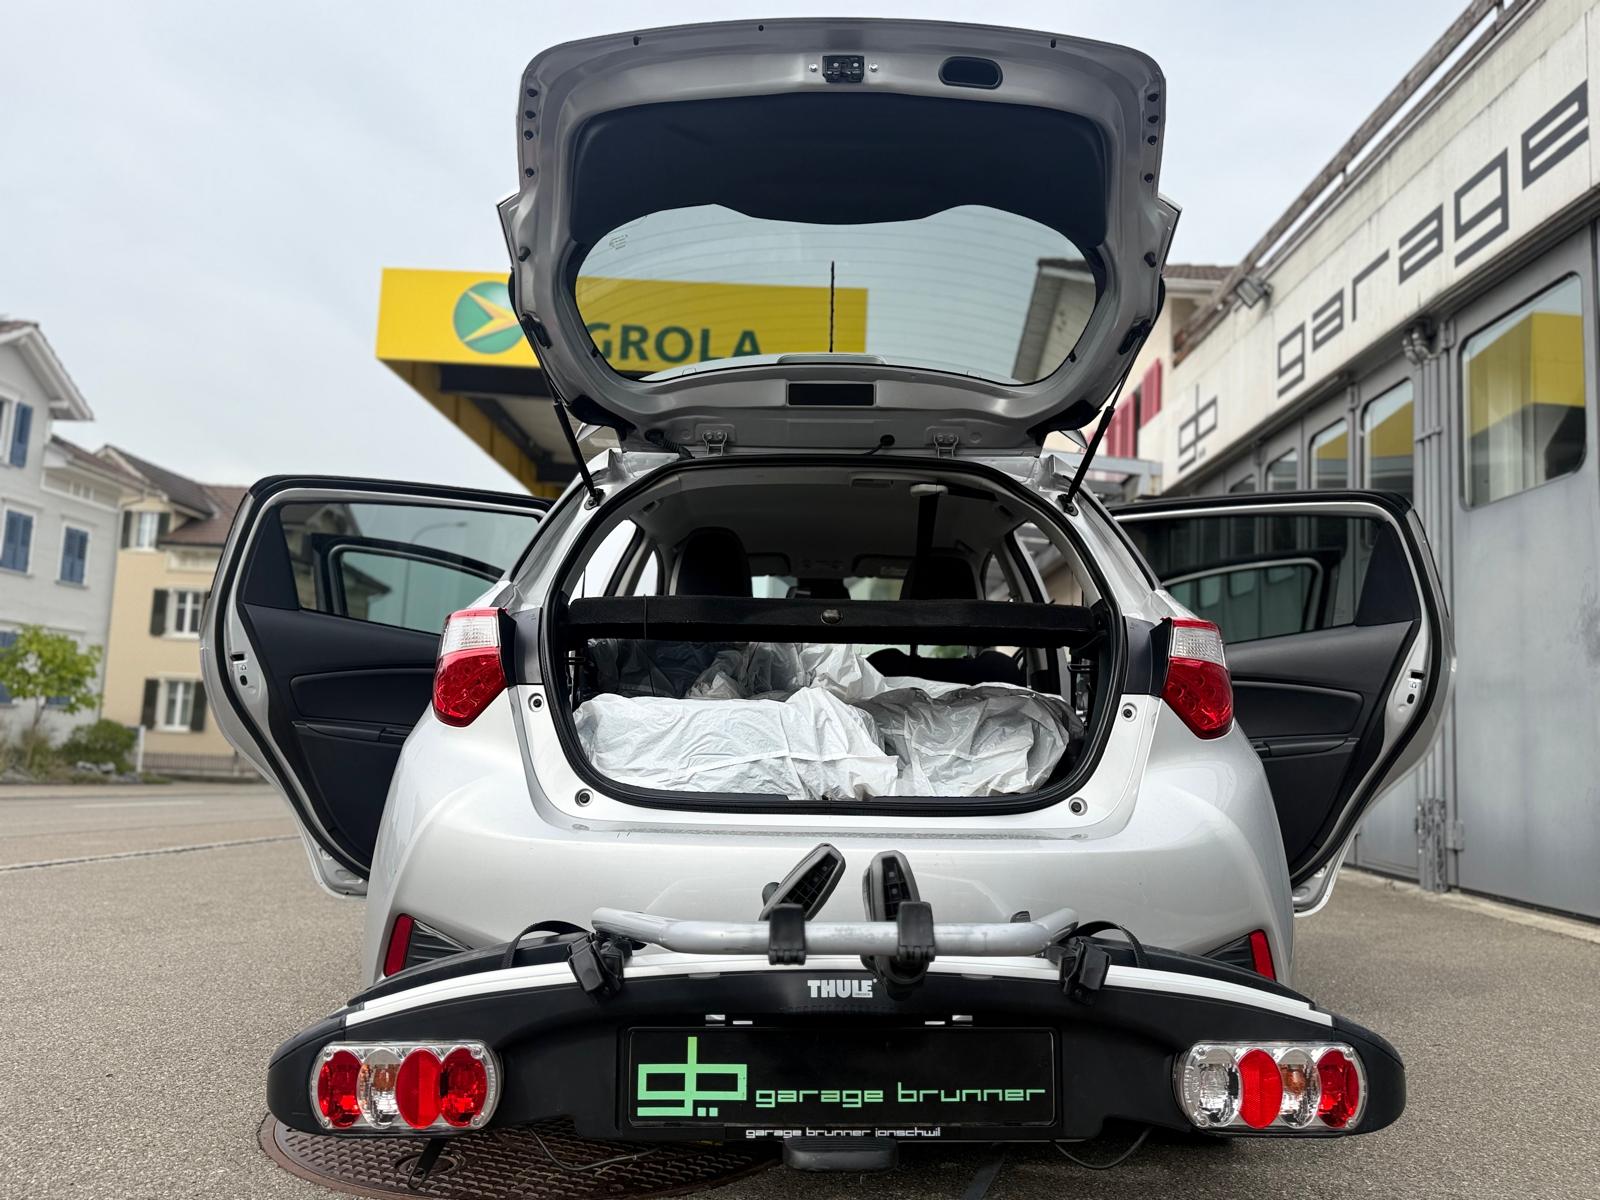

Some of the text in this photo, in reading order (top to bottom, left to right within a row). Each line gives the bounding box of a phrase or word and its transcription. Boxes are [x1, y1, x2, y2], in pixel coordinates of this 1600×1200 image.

[1276, 79, 1590, 399] garage
[807, 979, 874, 999] THULE
[755, 1089, 884, 1108] garage
[897, 1081, 1046, 1103] brunner
[745, 1128, 802, 1139] garage
[806, 1126, 871, 1137] brunner
